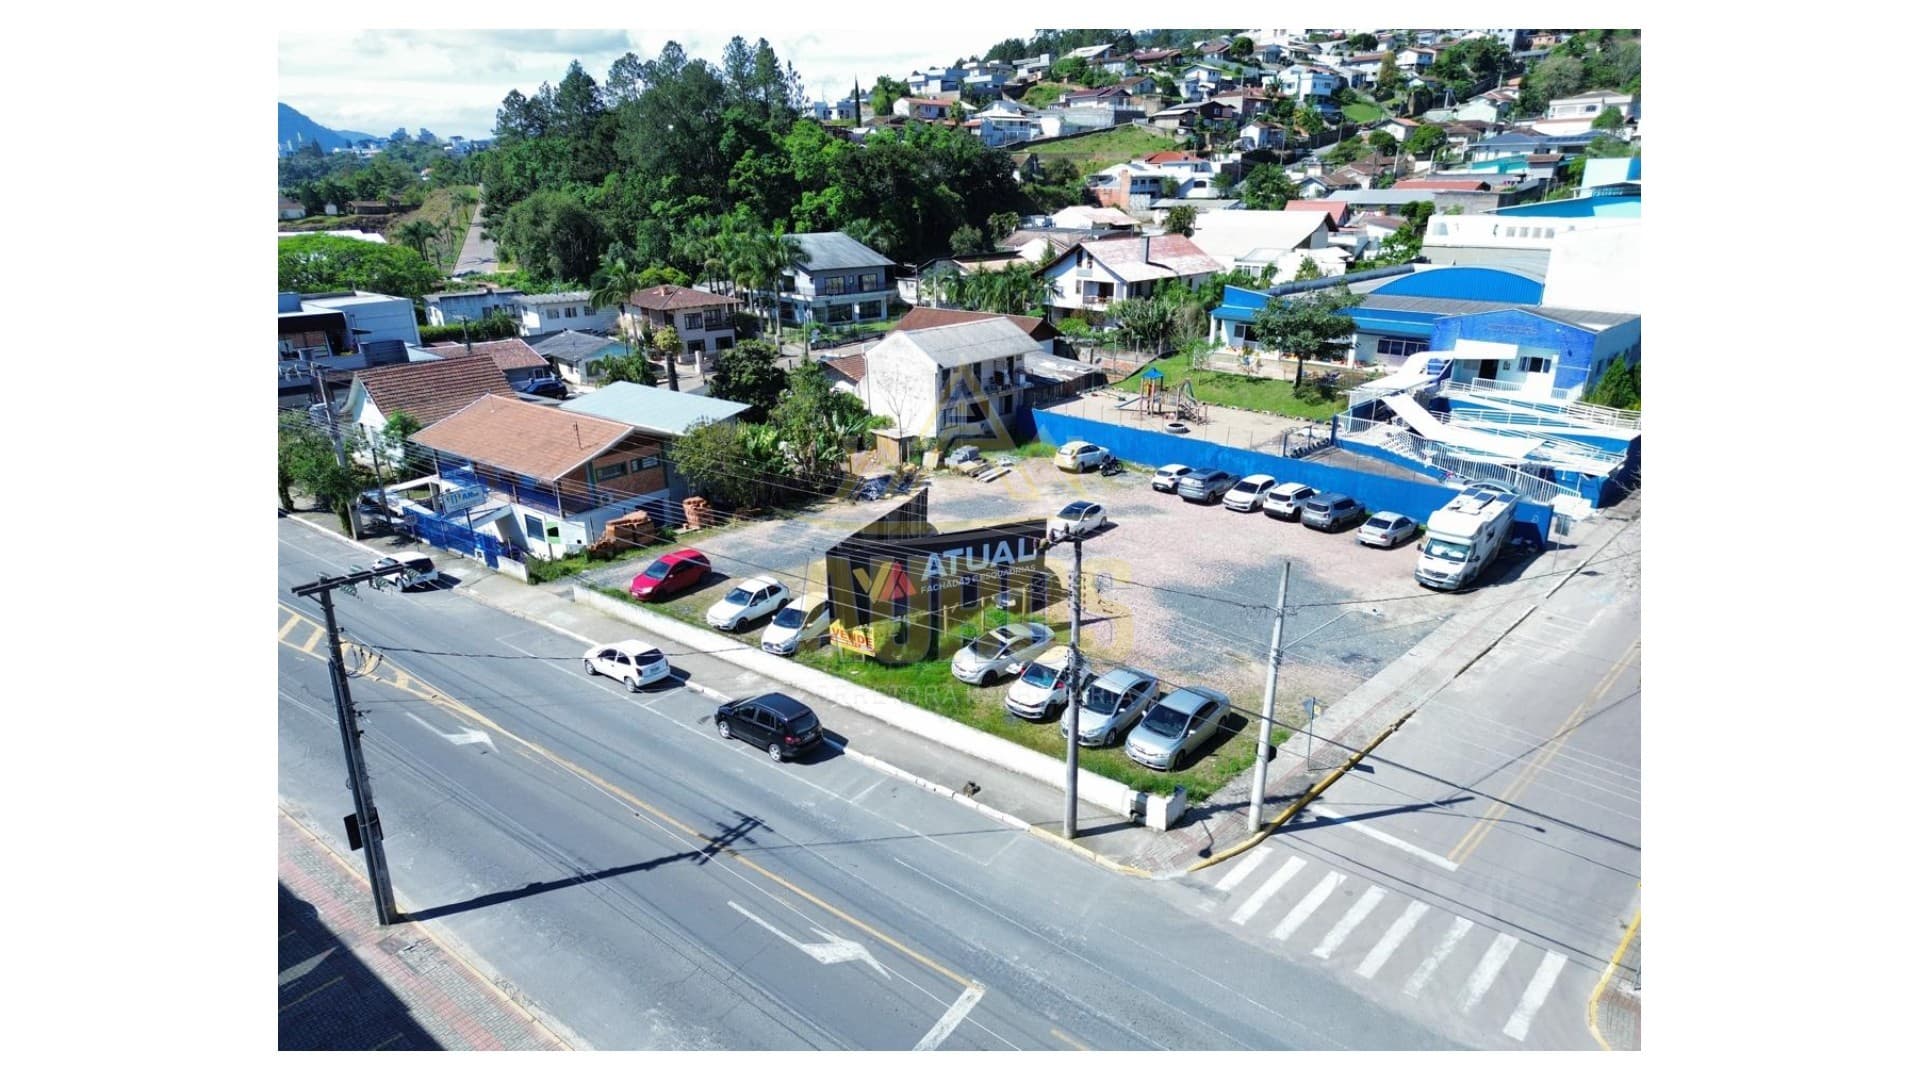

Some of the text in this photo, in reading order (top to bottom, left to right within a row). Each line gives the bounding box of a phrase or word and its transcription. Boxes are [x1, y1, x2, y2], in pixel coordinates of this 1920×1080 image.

[920, 538, 1037, 582] ATUAL
[920, 576, 971, 594] FACHADAS
[831, 626, 874, 651] VENDE
